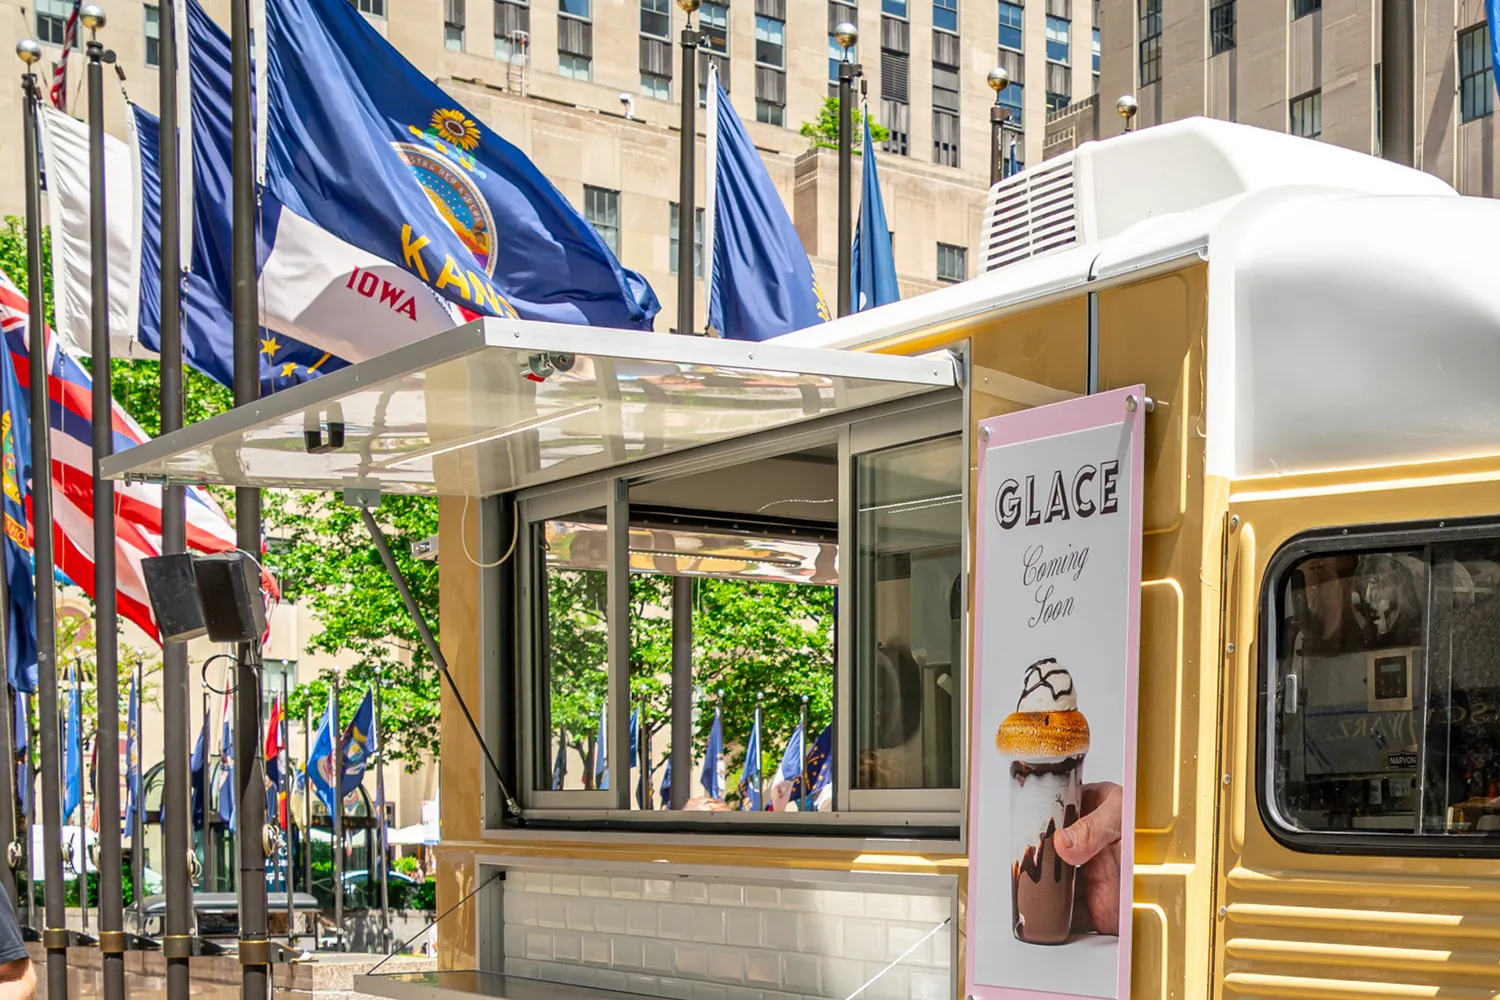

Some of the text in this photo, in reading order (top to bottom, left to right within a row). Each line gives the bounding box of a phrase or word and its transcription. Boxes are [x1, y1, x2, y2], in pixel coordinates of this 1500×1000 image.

[438, 168, 457, 185] PER
[346, 265, 417, 322] IOWA
[994, 459, 1119, 530] GLACE
[1023, 543, 1090, 587] Coming
[1028, 584, 1076, 628] Soon
